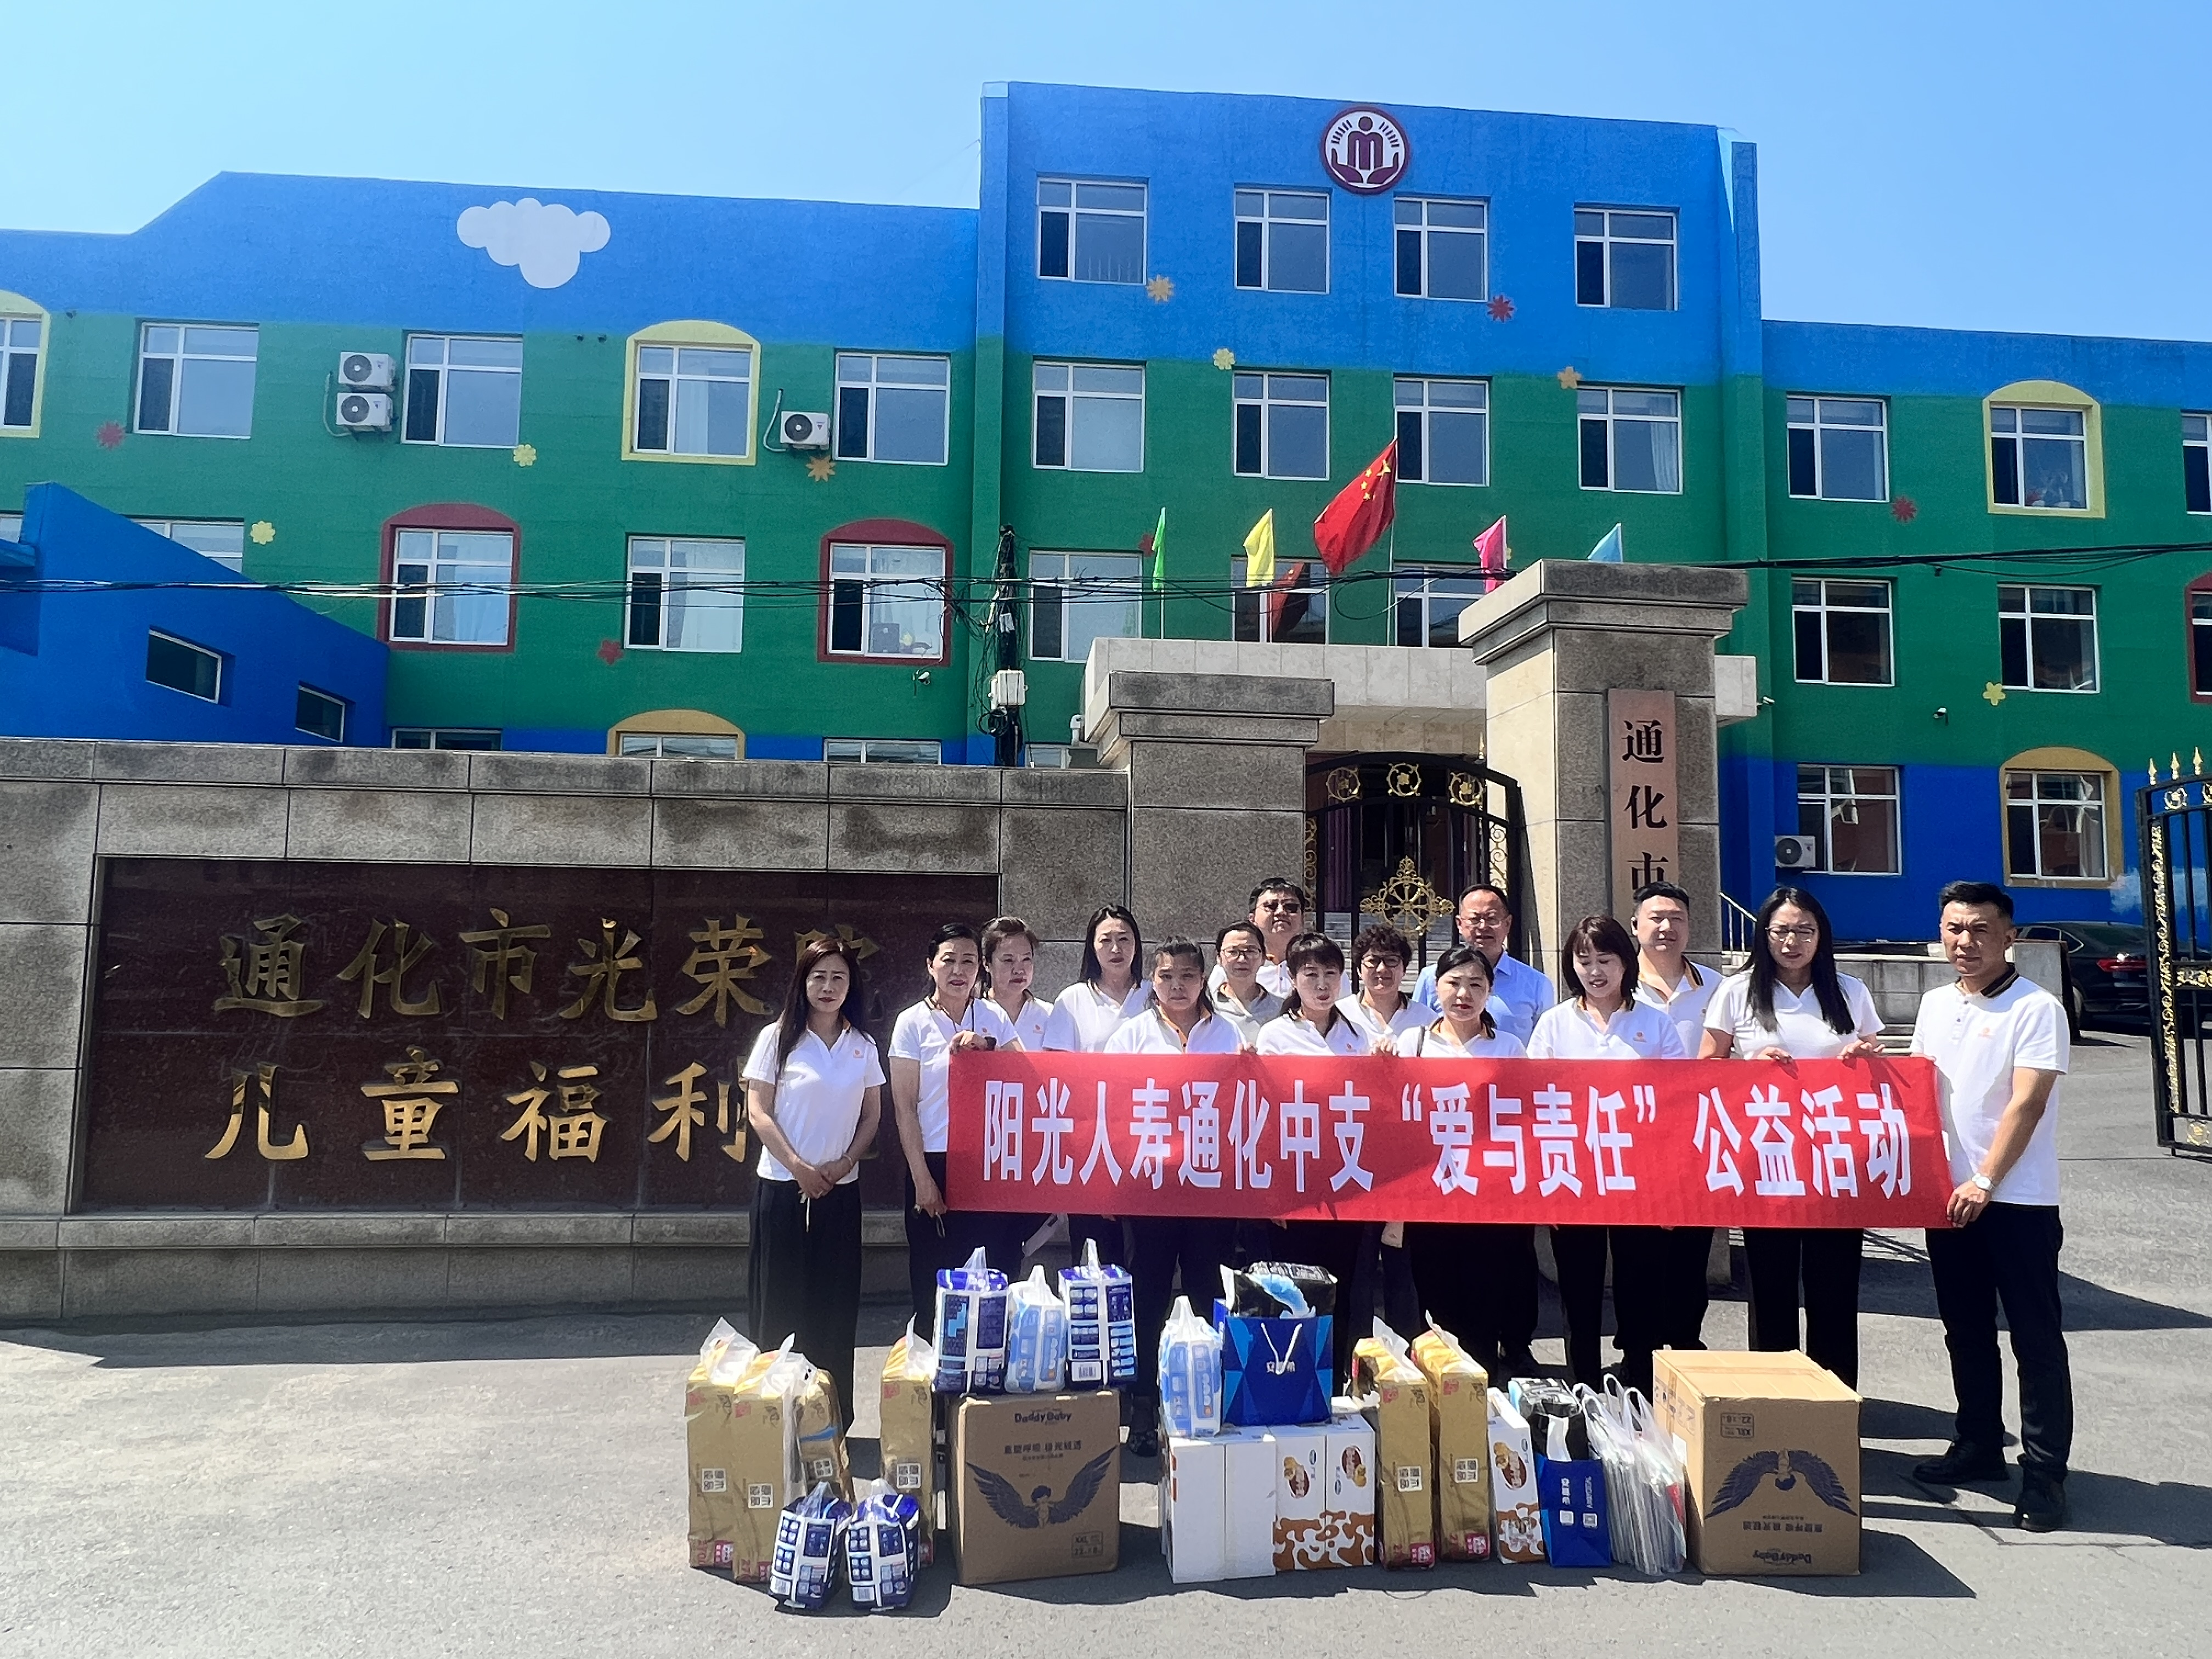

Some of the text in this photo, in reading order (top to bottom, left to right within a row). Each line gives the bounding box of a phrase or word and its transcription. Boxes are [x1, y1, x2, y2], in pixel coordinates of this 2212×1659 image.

[1622, 720, 1669, 890] 通化市
[204, 1045, 878, 1164] 儿童福利
